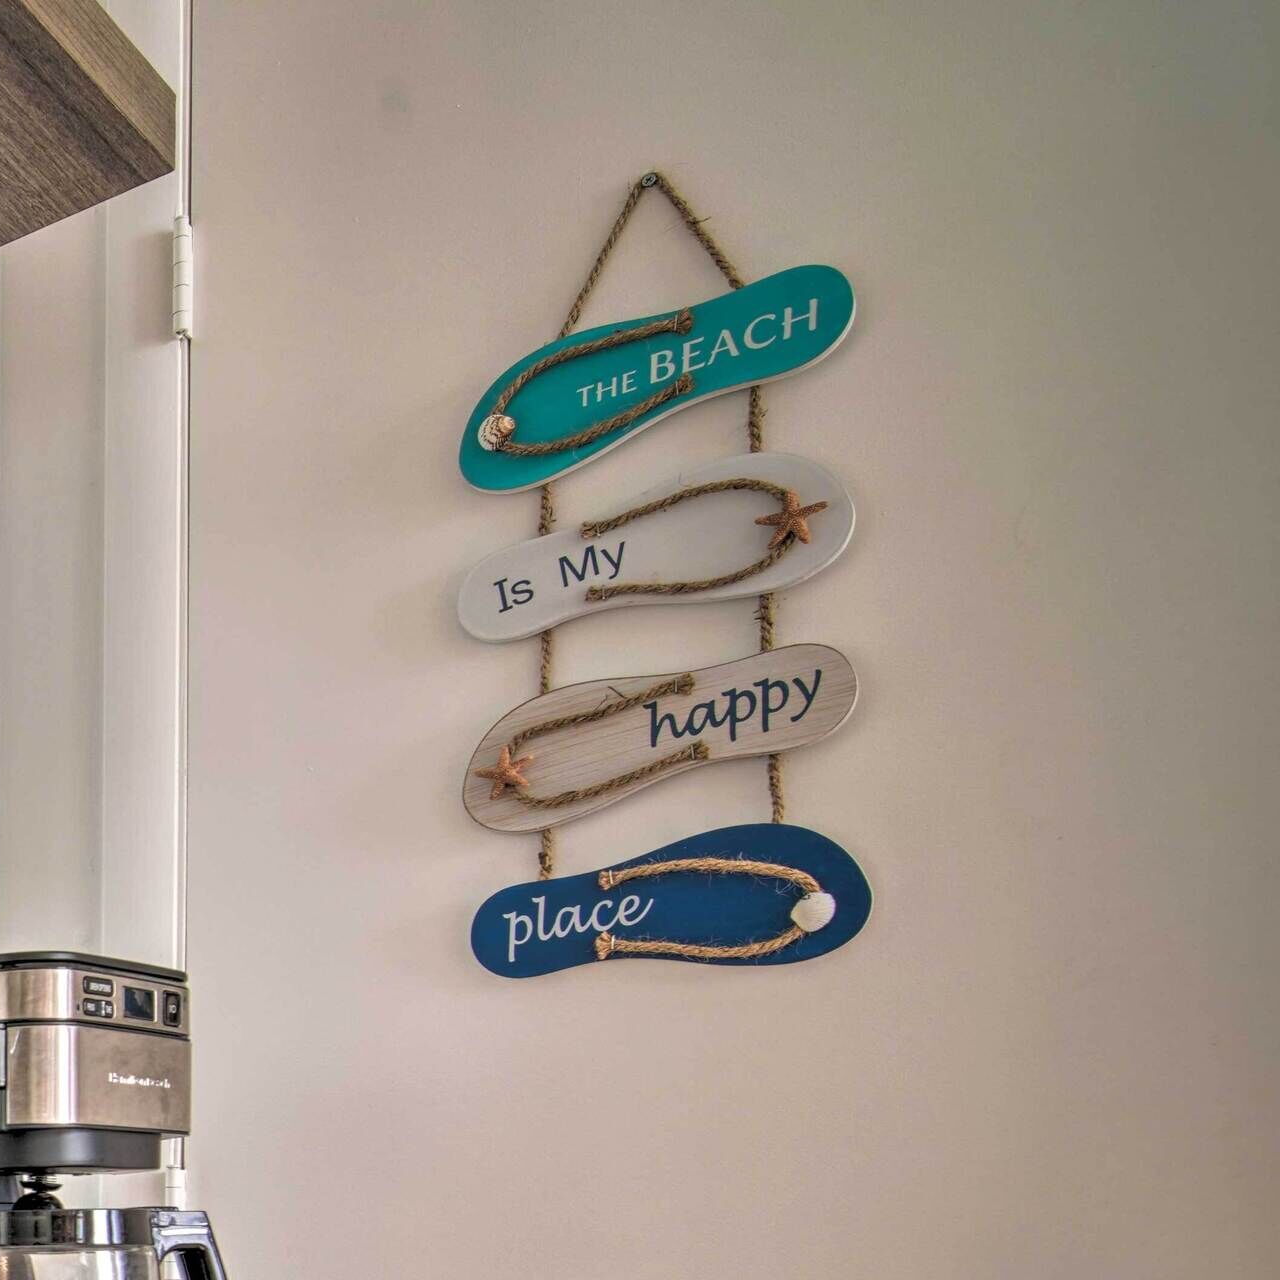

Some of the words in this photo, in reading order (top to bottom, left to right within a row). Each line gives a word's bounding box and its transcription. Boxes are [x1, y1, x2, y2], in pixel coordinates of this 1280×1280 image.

[575, 368, 638, 408] THE
[648, 297, 820, 385] BEACH
[492, 576, 535, 614] Is
[557, 540, 628, 588] My
[643, 668, 823, 748] happy
[502, 893, 655, 963] place
